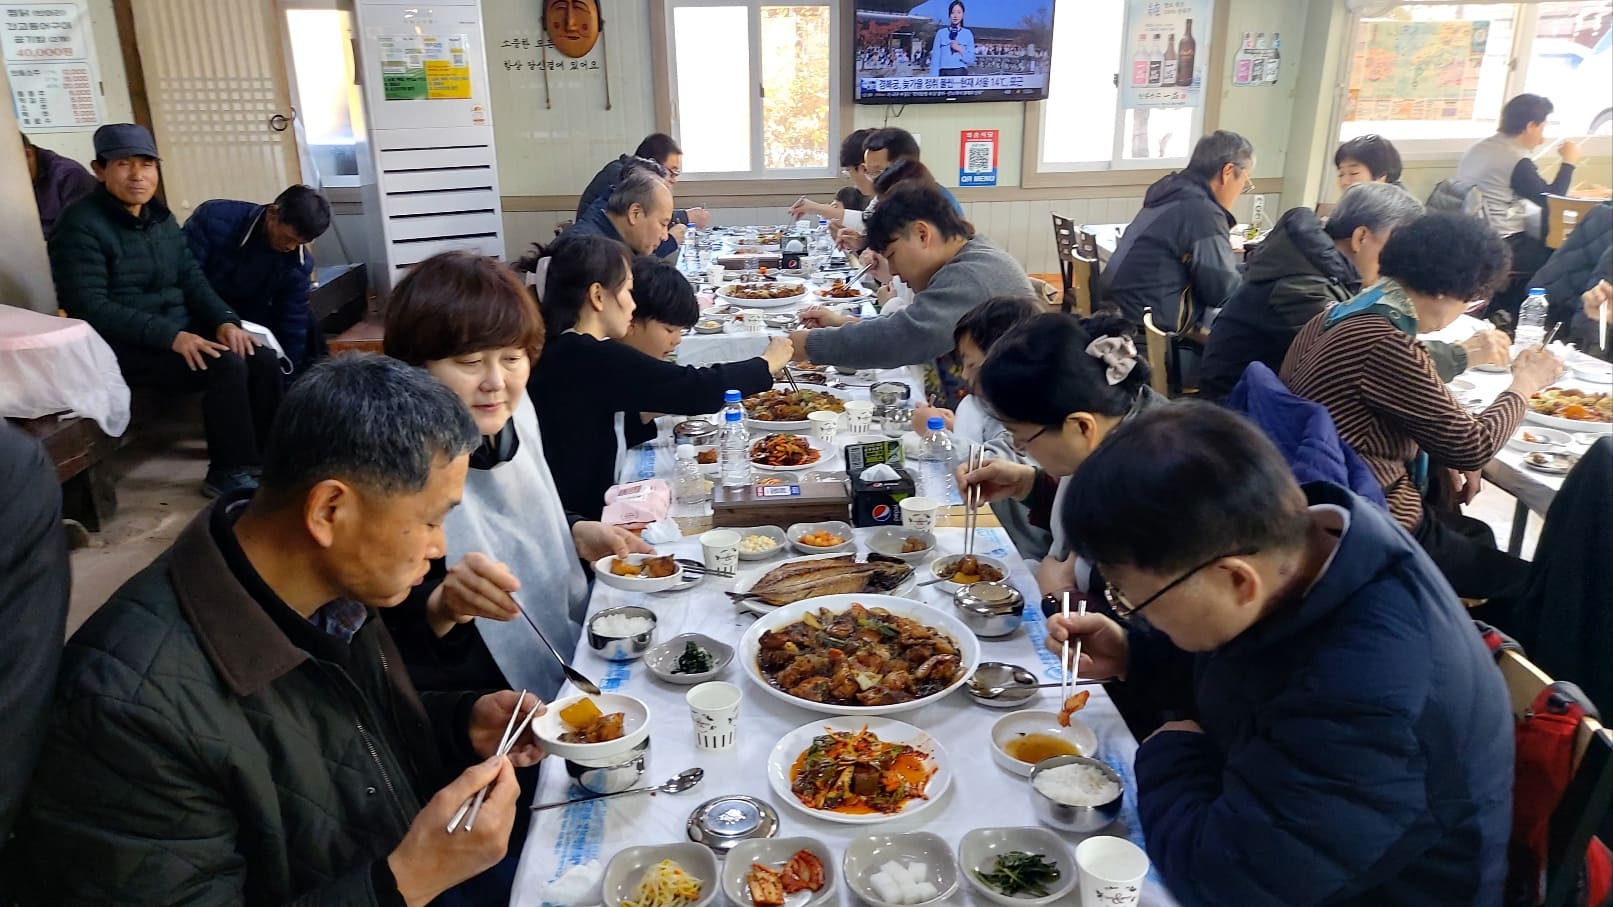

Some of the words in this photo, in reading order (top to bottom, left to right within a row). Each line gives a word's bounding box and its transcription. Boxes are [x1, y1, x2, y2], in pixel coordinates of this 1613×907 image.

[500, 38, 530, 50] 소중한
[503, 59, 523, 71] 항상
[570, 59, 600, 70] 있어요
[961, 175, 973, 183] QR
